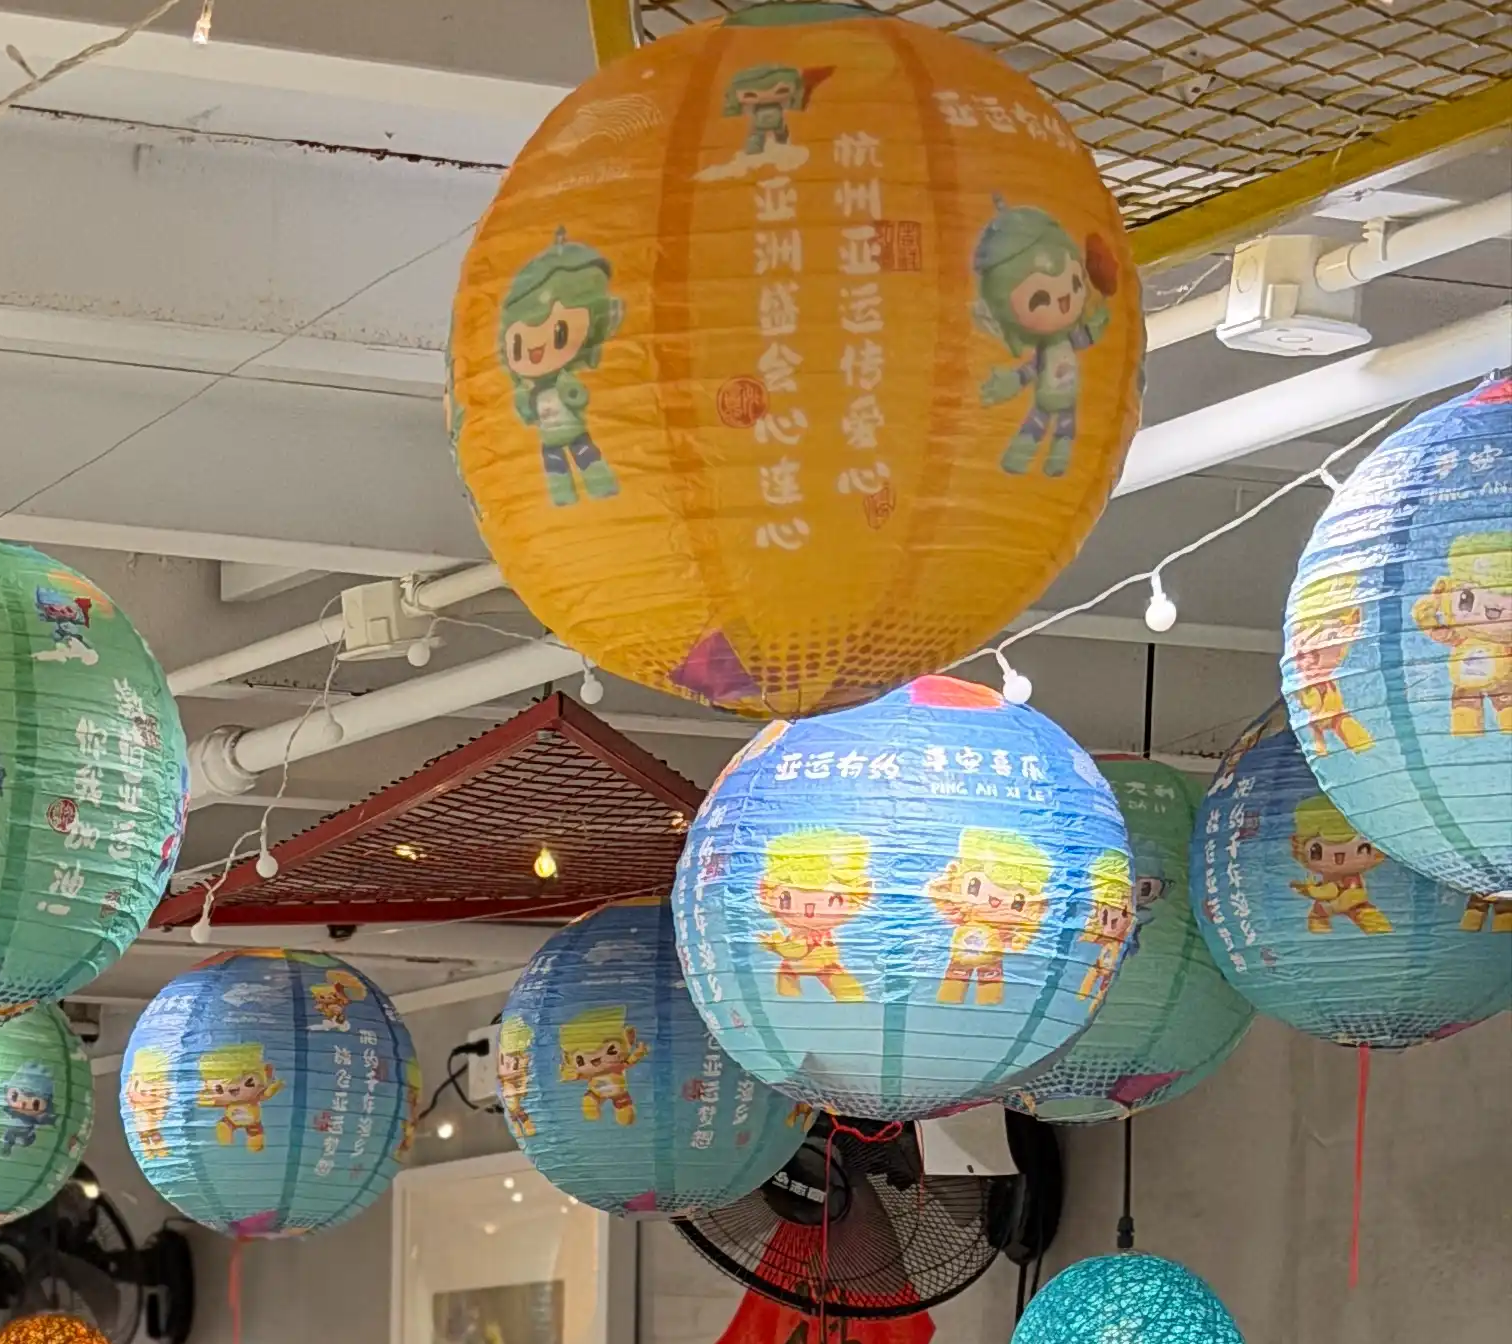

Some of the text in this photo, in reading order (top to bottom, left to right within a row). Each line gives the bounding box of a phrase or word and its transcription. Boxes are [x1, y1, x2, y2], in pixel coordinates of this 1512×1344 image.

[754, 175, 810, 551] 亚洲盛会心连心
[832, 131, 891, 496] 杭州亚运传爱心
[774, 744, 1048, 781] 亚运有约 平安喜乐
[931, 781, 968, 795] PING
